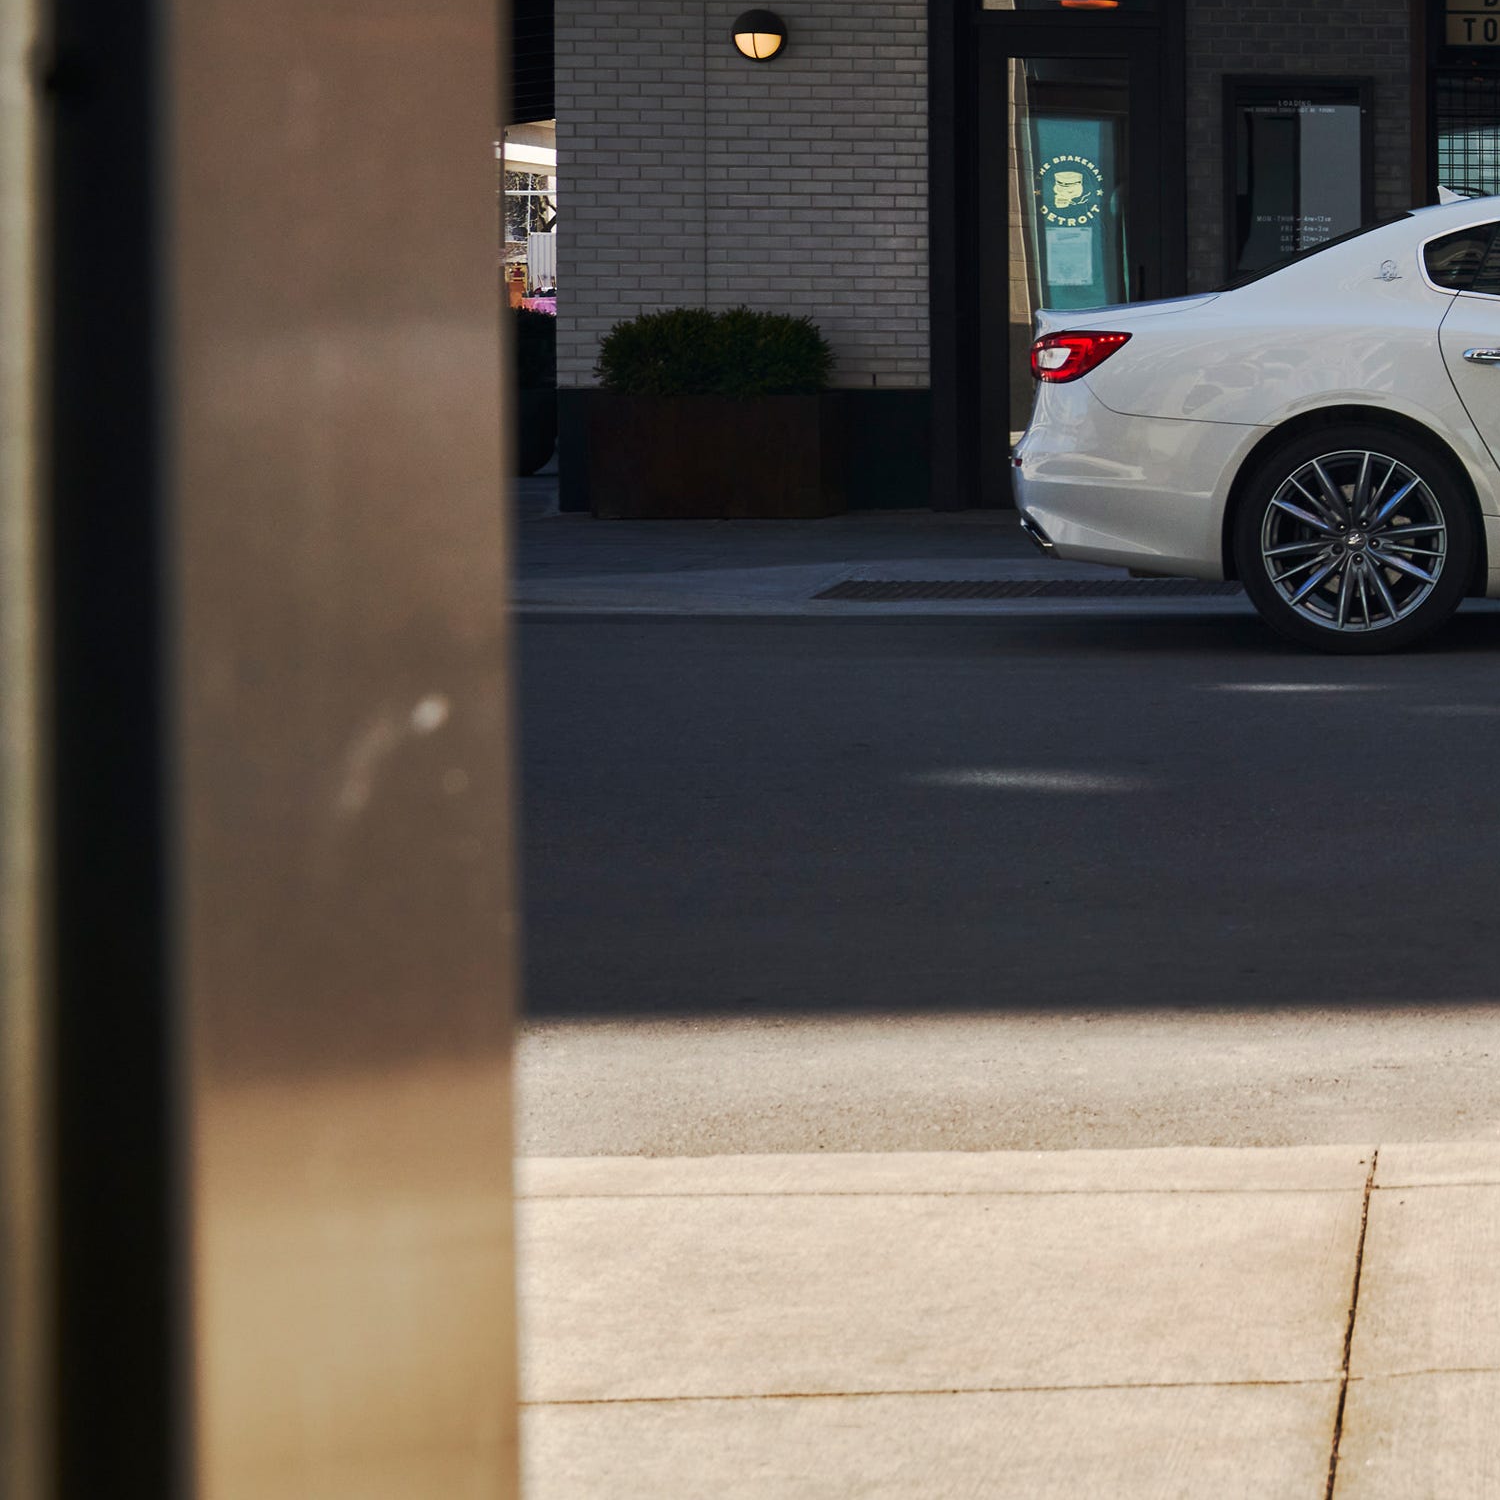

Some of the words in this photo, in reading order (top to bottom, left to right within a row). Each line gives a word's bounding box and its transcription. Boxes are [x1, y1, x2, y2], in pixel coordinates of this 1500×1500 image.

[1036, 163, 1051, 180] THE
[1053, 155, 1104, 182] BRAKEMAN
[1040, 204, 1100, 226] DETROIT
